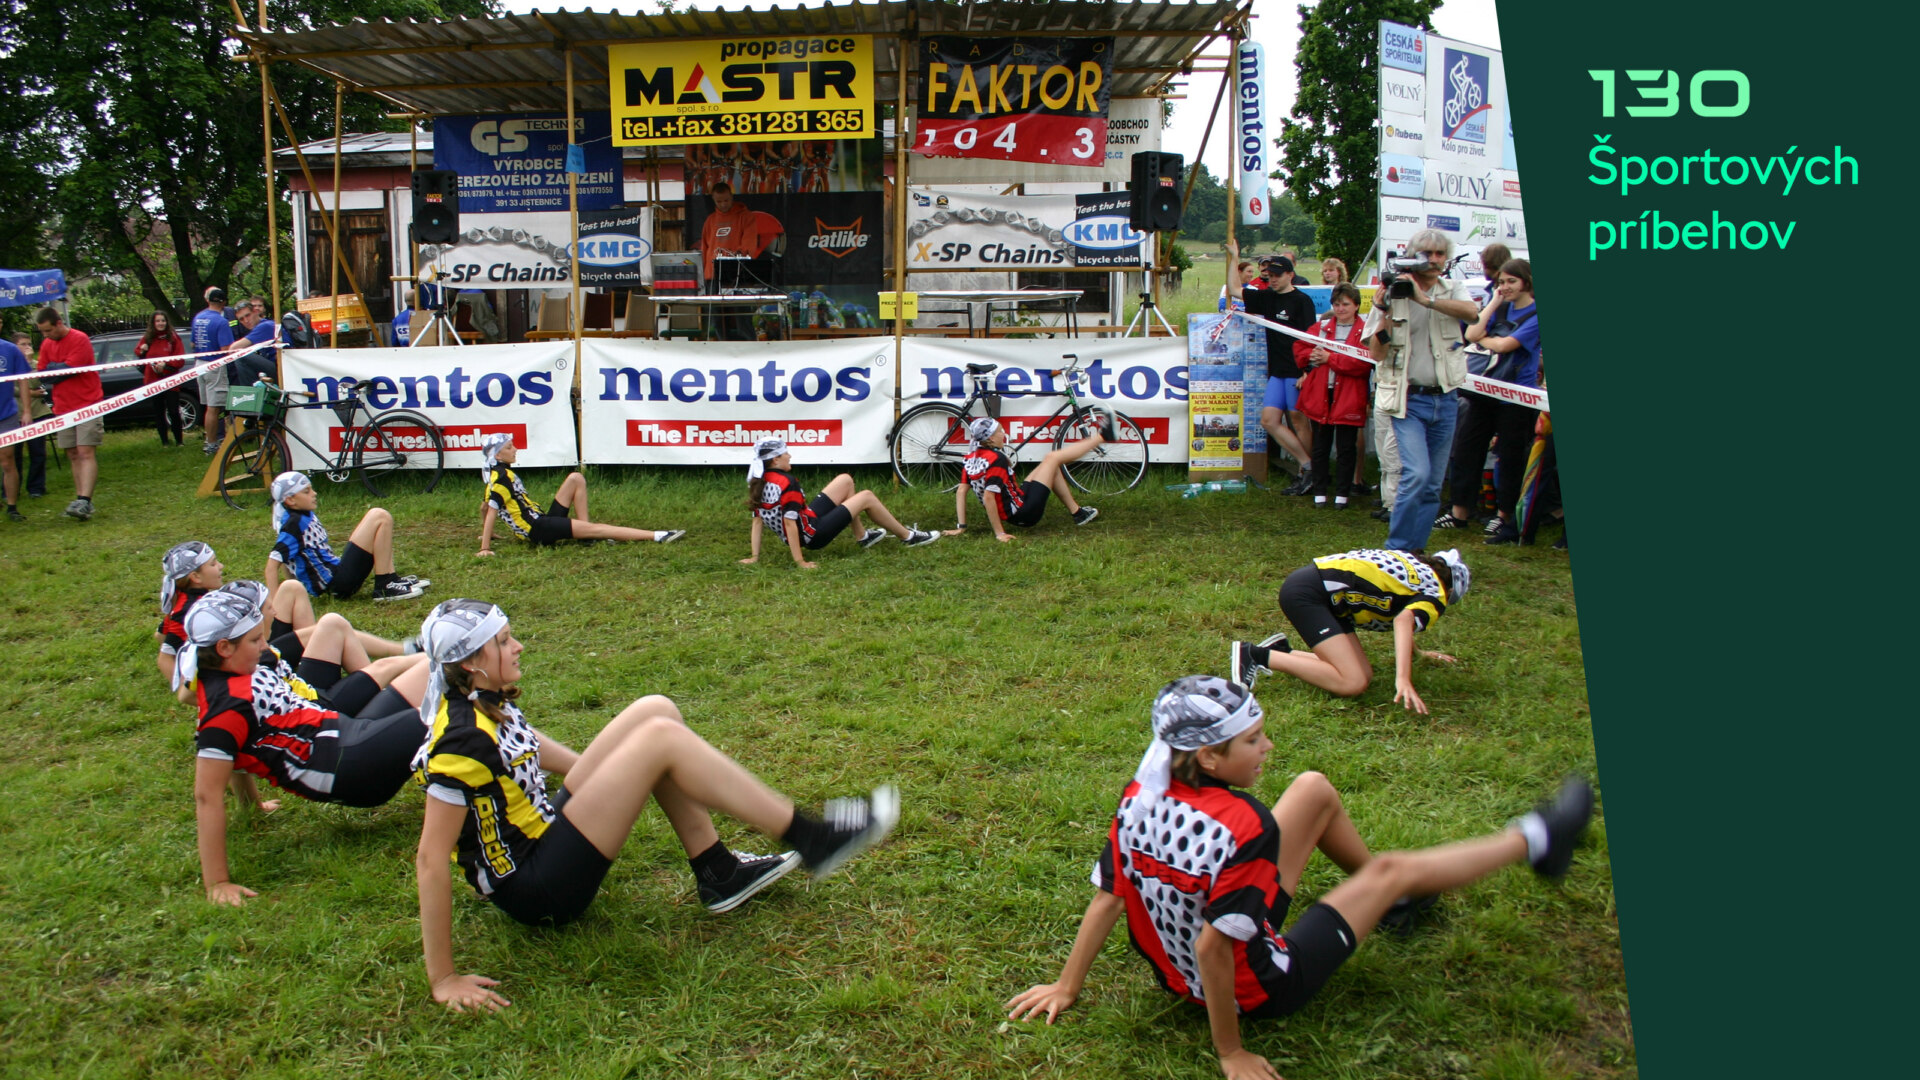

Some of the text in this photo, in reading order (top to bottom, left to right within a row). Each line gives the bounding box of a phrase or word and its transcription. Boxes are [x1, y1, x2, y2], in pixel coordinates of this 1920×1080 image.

[929, 41, 1105, 57] RADIO
[1385, 30, 1413, 50] ČESKÁ
[721, 38, 855, 62] propagace
[624, 60, 856, 107] MASTR
[927, 61, 1103, 114] FAKTOR
[1386, 82, 1421, 101] VOLNÝ
[676, 105, 698, 114] spol.
[1240, 48, 1263, 172] mentos
[526, 119, 582, 130] TECHNK
[623, 116, 715, 138] tel.+fax
[815, 110, 861, 131] 365
[1395, 127, 1422, 140] Rubena
[470, 119, 529, 156] GS
[924, 123, 1095, 159] 104.3
[1442, 140, 1456, 152] Kolo
[1457, 145, 1468, 155] pro
[493, 157, 563, 171] VÝROBCE
[1437, 172, 1492, 200] VOLNÝ
[519, 198, 562, 207] JISTEBNICE
[1099, 202, 1114, 211] the
[600, 220, 614, 229] the
[1481, 226, 1496, 238] Cycle
[577, 240, 641, 258] KMC
[808, 231, 869, 248] catlike
[913, 242, 1065, 264] X-SP Chains
[1077, 255, 1139, 265] bicycle chain
[487, 262, 569, 282] Chains
[580, 272, 612, 281] bicycle
[19, 285, 44, 296] Team
[301, 367, 555, 410] mentos
[599, 360, 872, 403] mentos
[920, 359, 1189, 401] mentos
[638, 423, 831, 444] The Freshmaker
